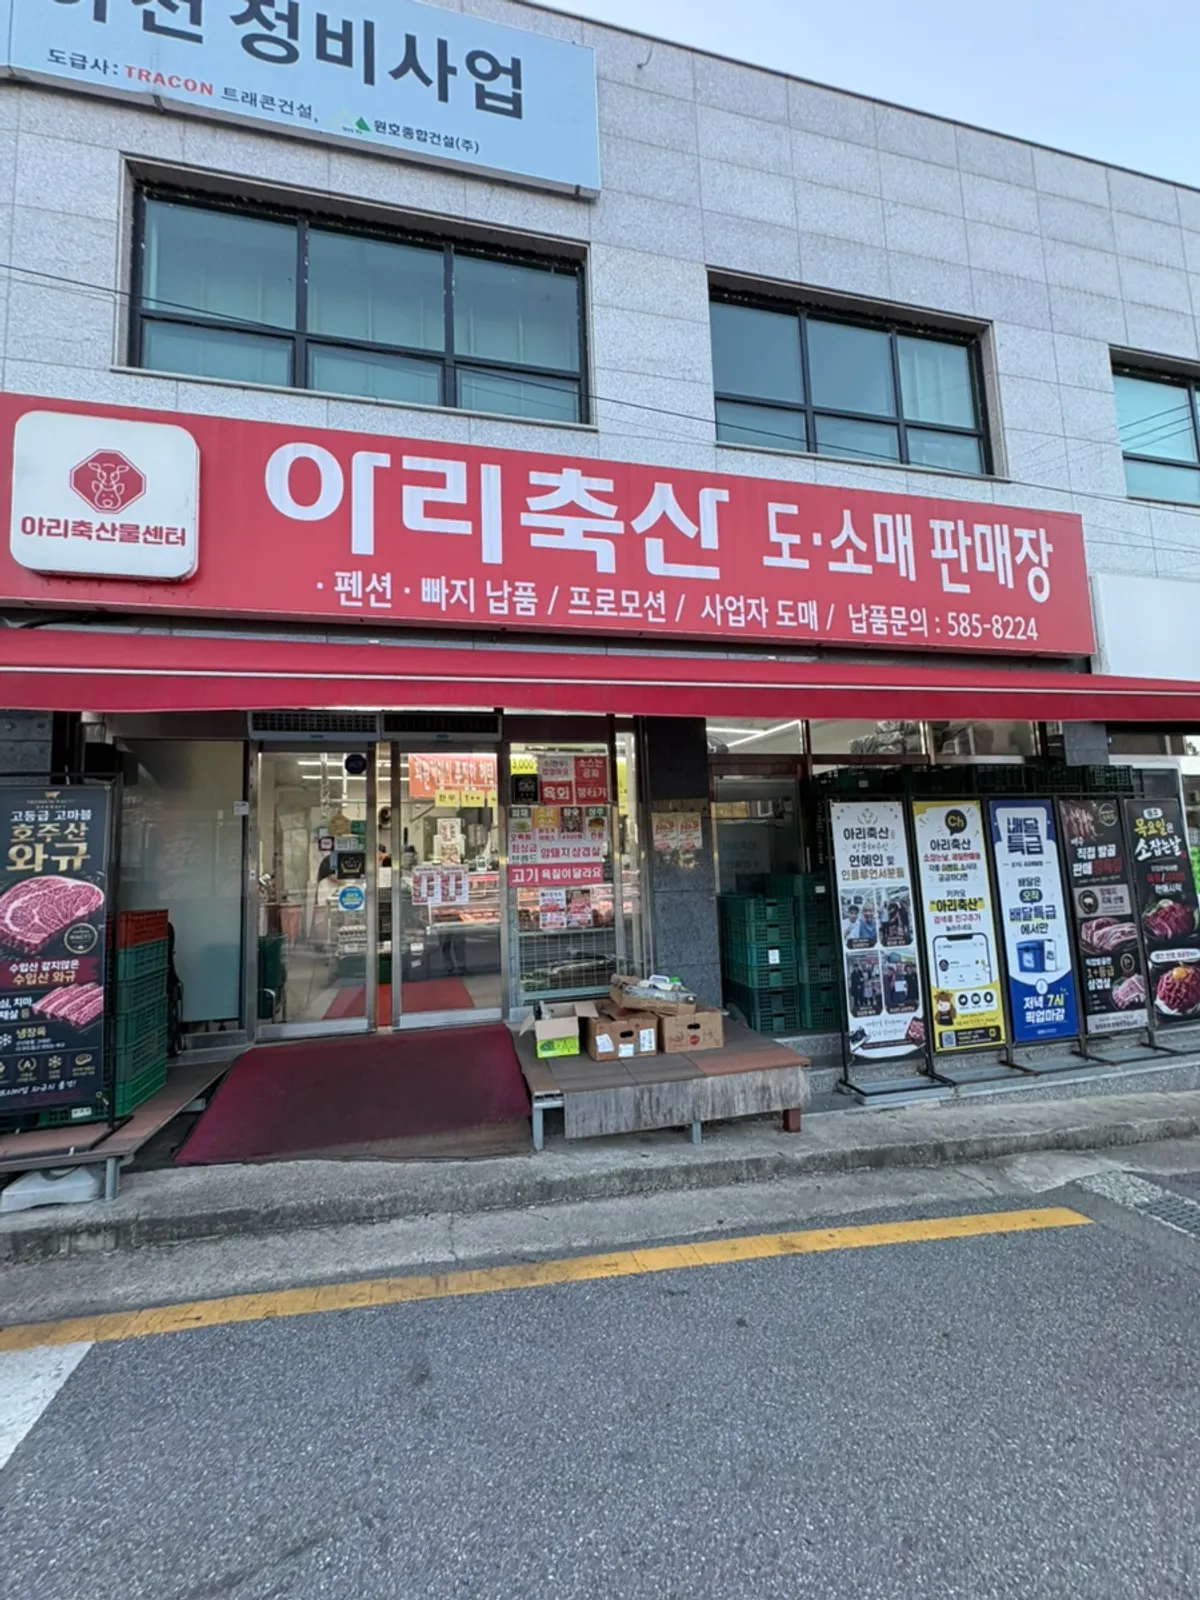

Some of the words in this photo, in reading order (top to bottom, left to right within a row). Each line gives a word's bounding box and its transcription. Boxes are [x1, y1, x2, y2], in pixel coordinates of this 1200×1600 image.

[229, 0, 523, 119] 정비사업
[47, 48, 119, 76] 도급사:
[124, 65, 214, 96] TRACON
[220, 86, 319, 124] 트래콘건설,
[373, 119, 481, 154] 원호종합건설(주)
[21, 515, 187, 547] 아리축산물센터
[265, 442, 729, 580] 아리축산
[763, 502, 917, 582] 도·소매
[929, 519, 1053, 603] 판매장
[333, 571, 392, 609] 펜션
[420, 575, 475, 613] 빠지
[485, 579, 539, 616] 납품
[568, 586, 667, 623] 프로모션
[700, 594, 769, 629] 사업자
[776, 599, 819, 632] 도매
[849, 603, 929, 638] 납품문의
[947, 611, 1039, 641] 585-8224
[11, 809, 50, 822] 고등급
[947, 815, 964, 828] Ch
[6, 842, 91, 872] 와규
[929, 838, 971, 851] 아리축산
[1134, 835, 1182, 861] 소잡는날
[849, 853, 884, 868] 연예인
[512, 867, 539, 883] 고기
[13, 972, 50, 986] 수입산
[52, 970, 77, 983] 와규
